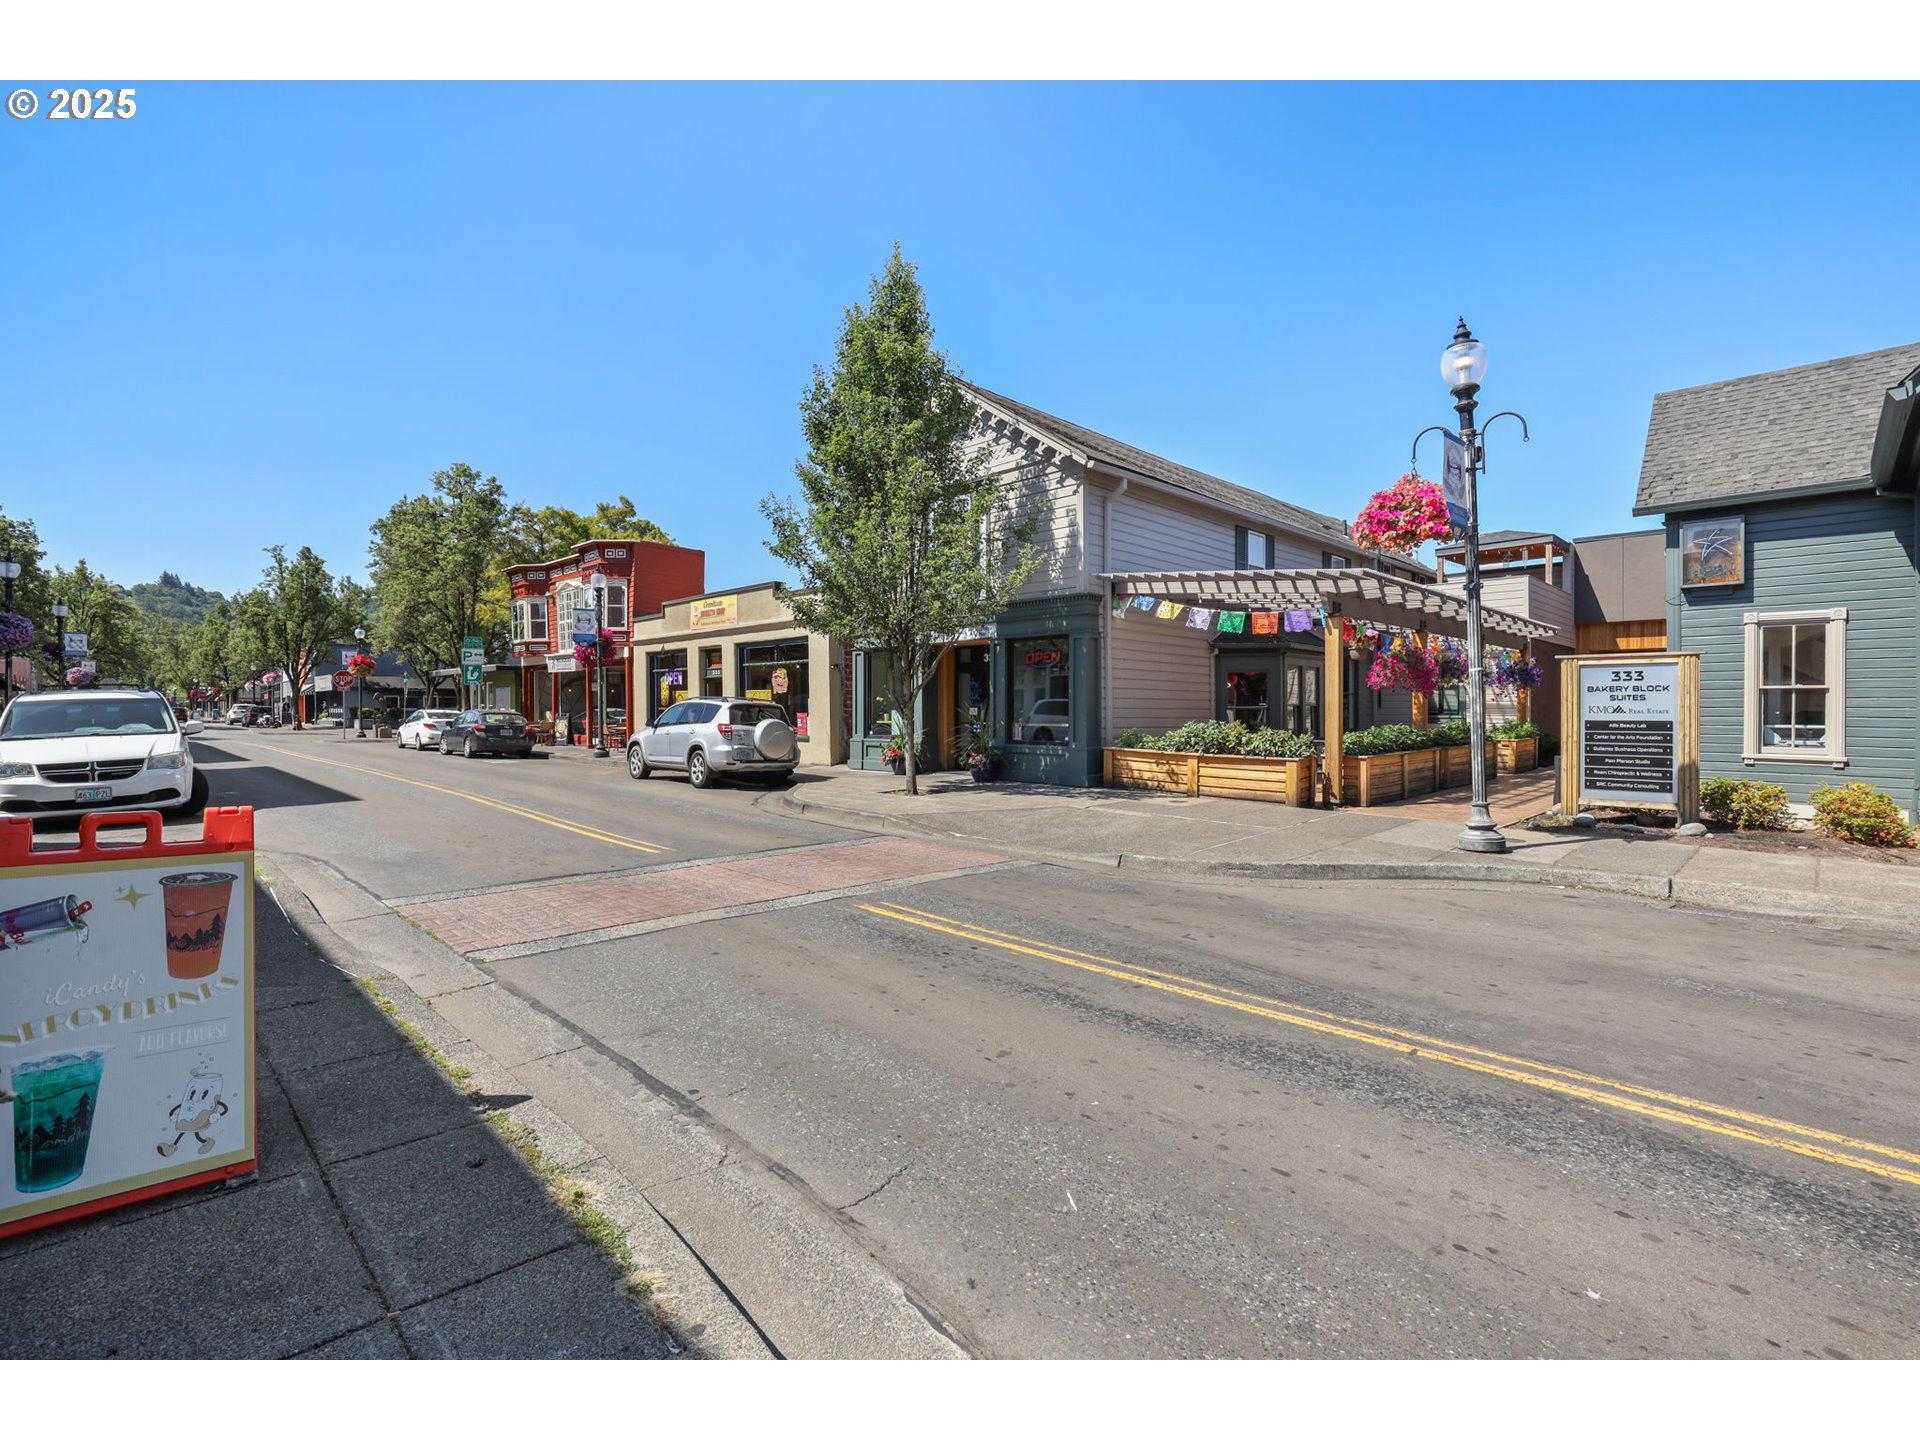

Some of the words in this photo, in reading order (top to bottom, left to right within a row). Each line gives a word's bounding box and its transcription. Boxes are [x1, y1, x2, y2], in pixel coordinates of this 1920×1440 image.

[1025, 650, 1061, 665] OPEN
[335, 675, 352, 683] STOP
[664, 672, 682, 685] OPEN
[1611, 671, 1644, 681] 333
[78, 791, 92, 799] 463
[45, 969, 146, 1006] iCandy's
[139, 1034, 165, 1052] ADD
[169, 1023, 226, 1047] FLAVORS!
